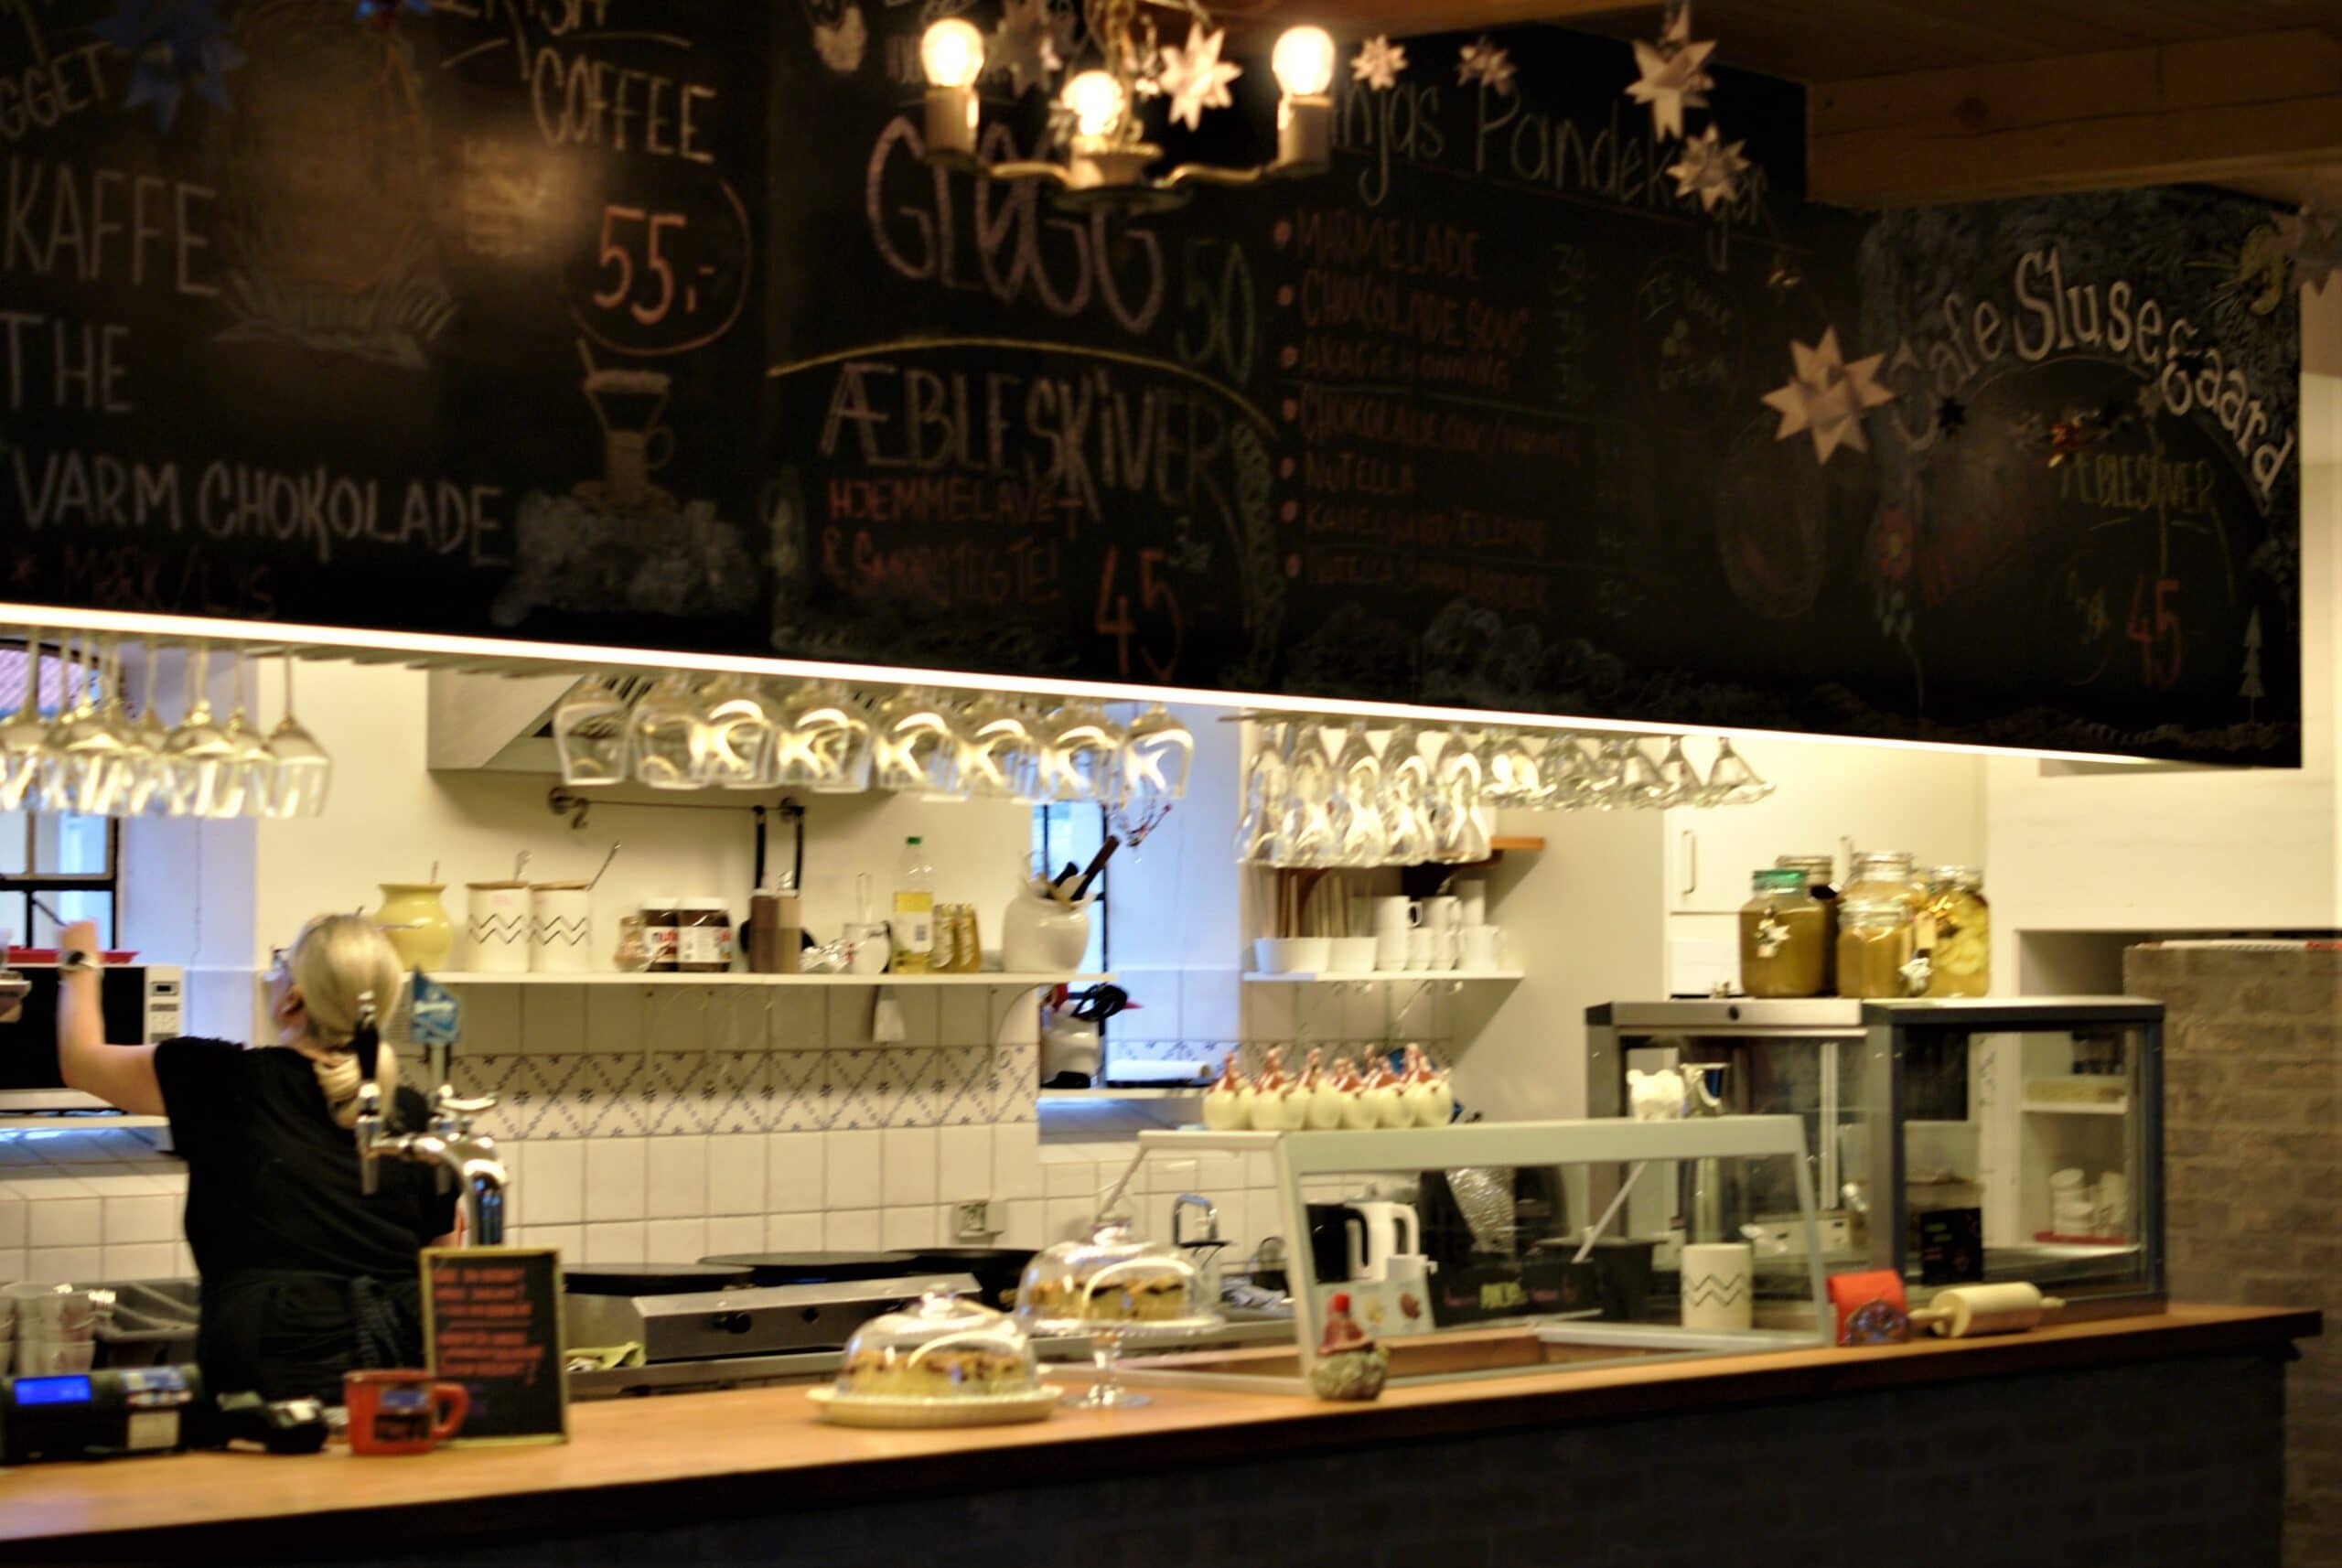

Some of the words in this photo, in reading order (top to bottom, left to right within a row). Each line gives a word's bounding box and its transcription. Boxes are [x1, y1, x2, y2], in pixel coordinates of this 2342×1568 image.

[531, 46, 718, 166] COFFEE
[2, 156, 220, 296] KAFFE
[0, 309, 134, 414] THE
[7, 446, 183, 532] VARM
[196, 461, 513, 569] CHOKOLADE
